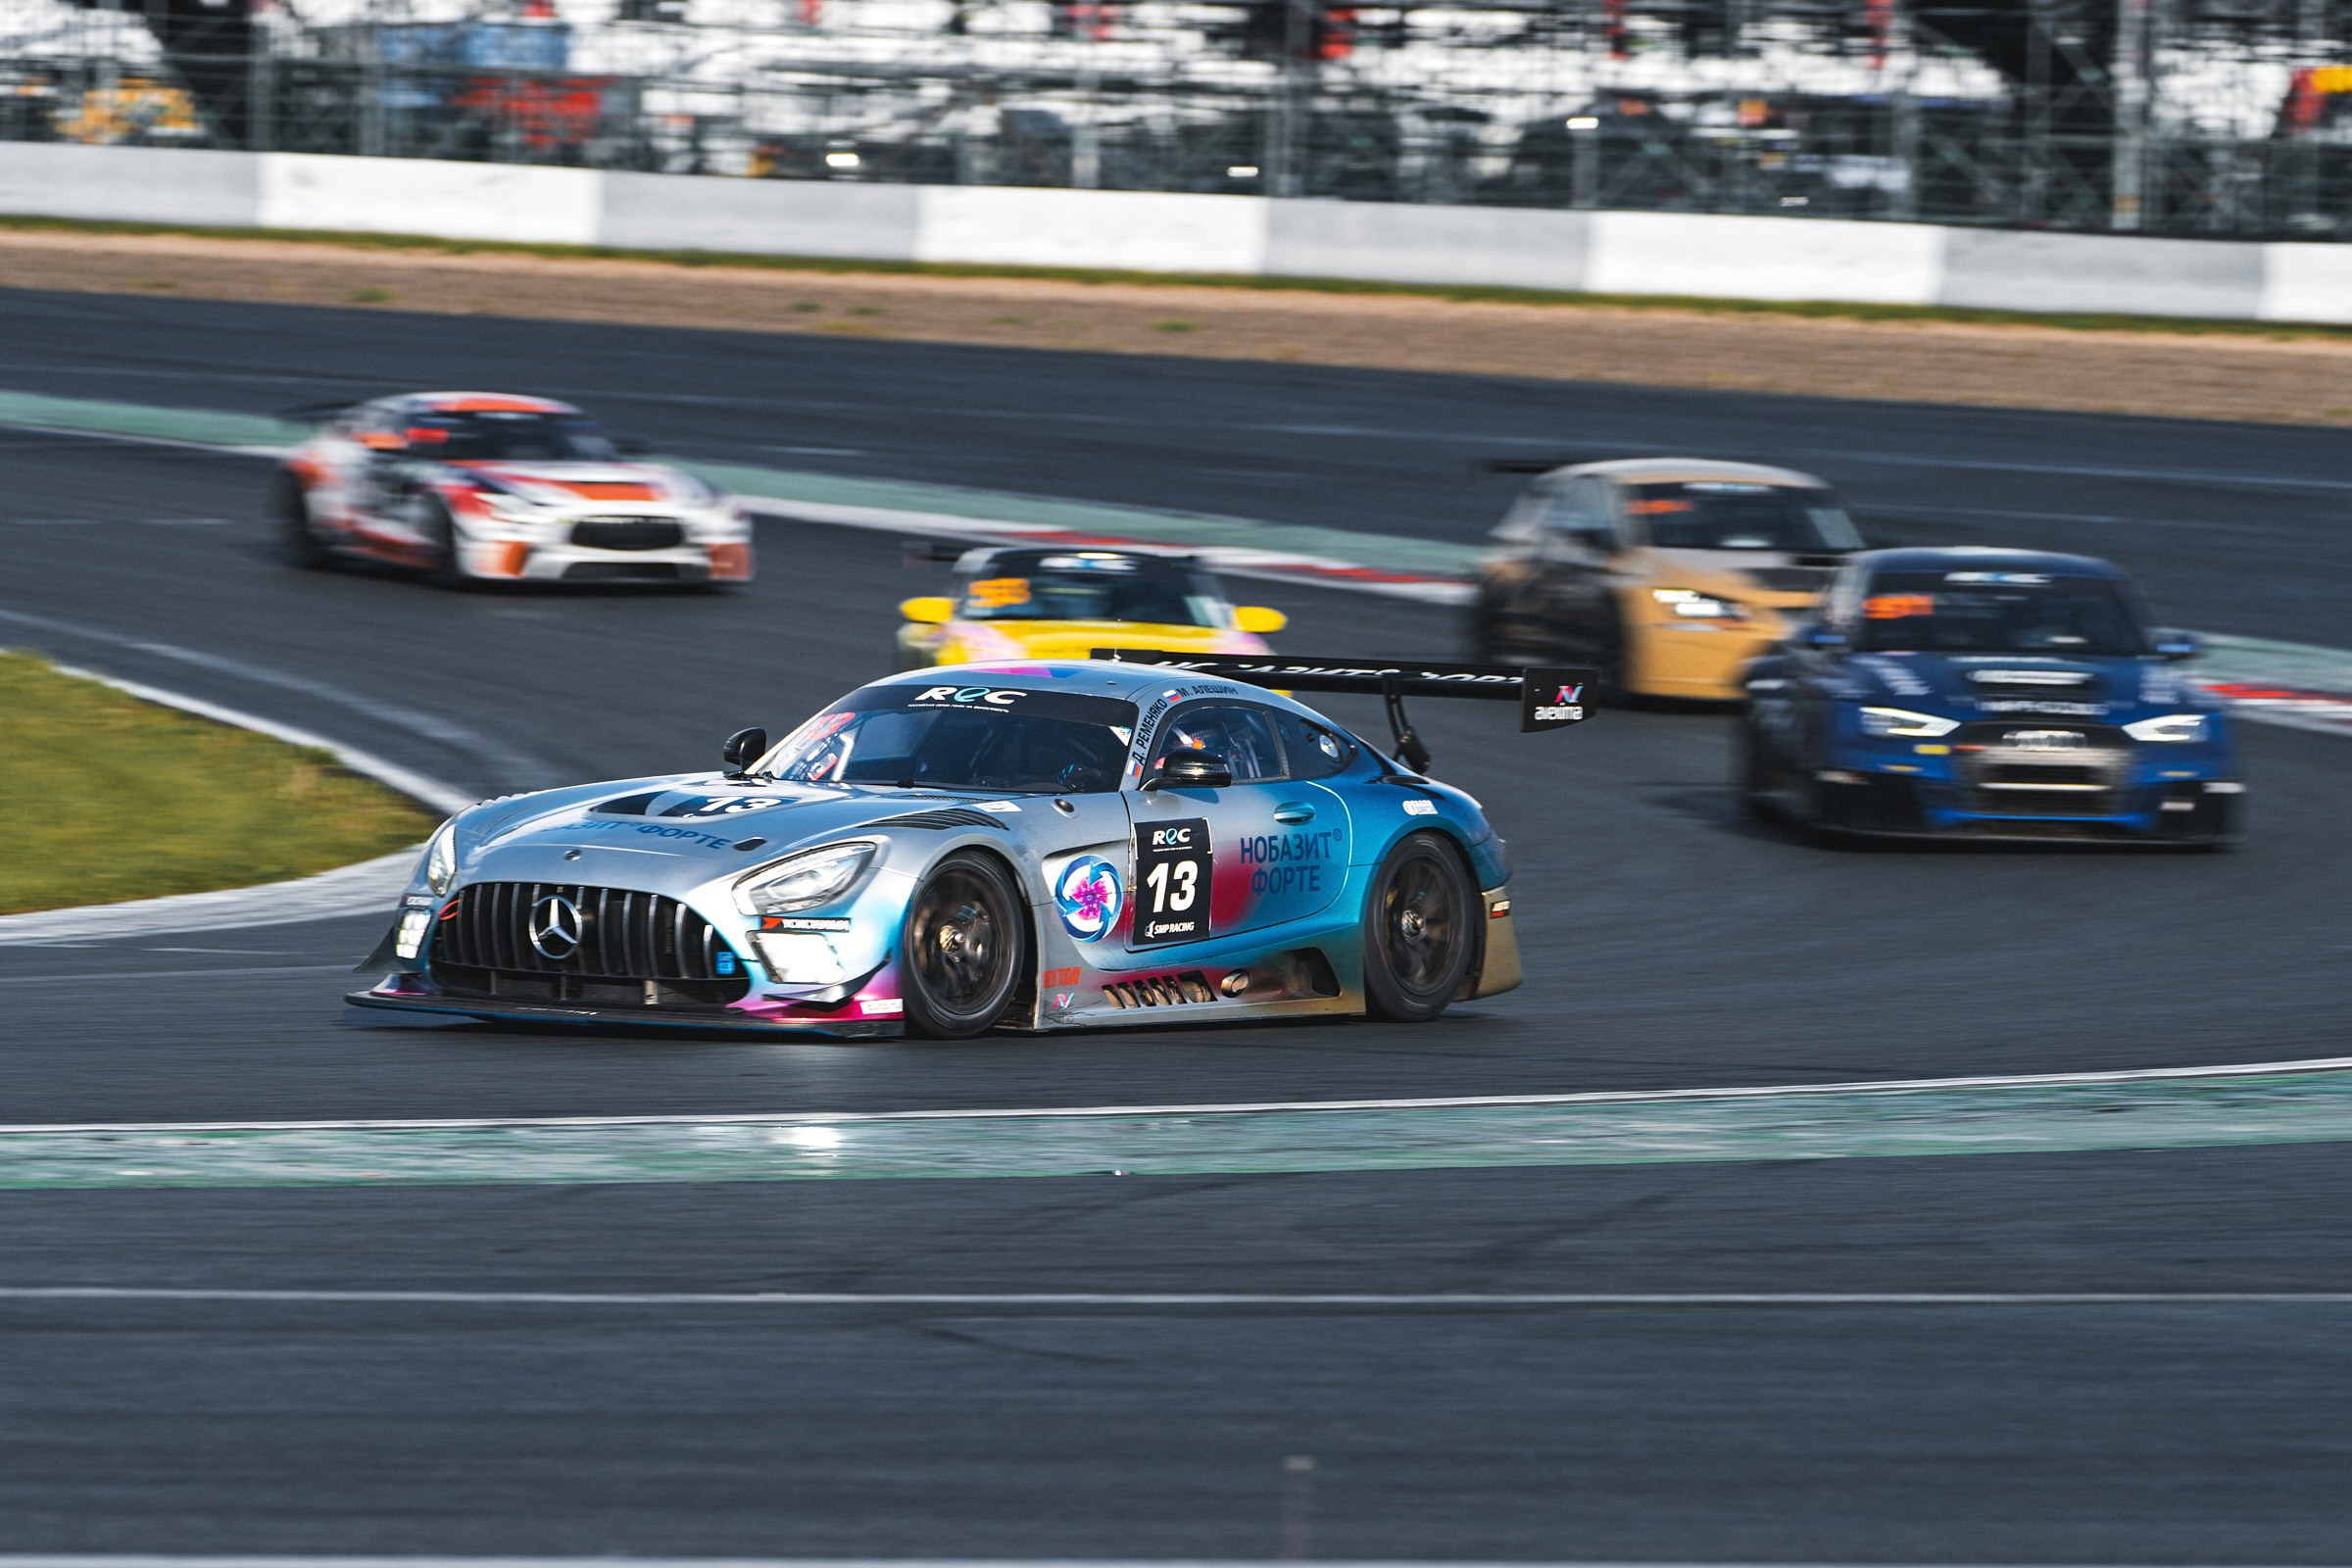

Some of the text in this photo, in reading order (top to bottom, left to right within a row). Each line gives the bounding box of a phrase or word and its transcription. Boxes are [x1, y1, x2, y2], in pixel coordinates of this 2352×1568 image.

[1177, 685, 1239, 698] М. АЛЕШИН
[1136, 698, 1168, 750] РЕМЕНЯКО
[700, 796, 782, 813] 13
[636, 825, 733, 850] ФОРТЕ
[1147, 860, 1199, 912] 13
[1251, 865, 1321, 897] ФОРТЕ
[1169, 922, 1195, 933] RACING
